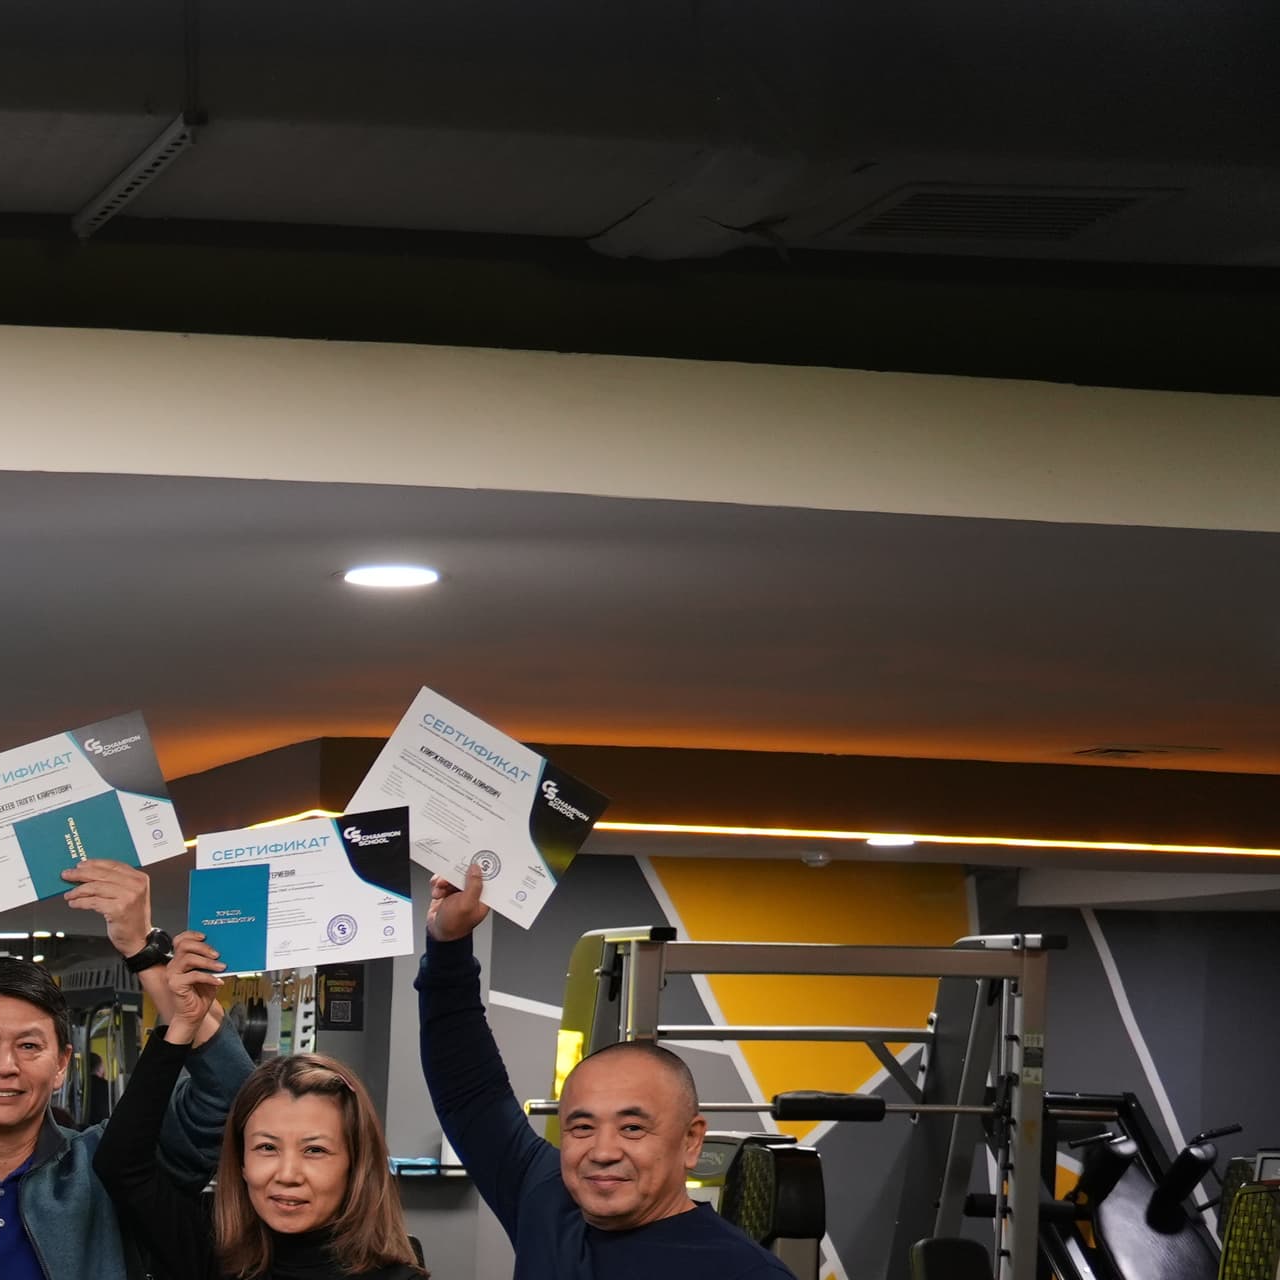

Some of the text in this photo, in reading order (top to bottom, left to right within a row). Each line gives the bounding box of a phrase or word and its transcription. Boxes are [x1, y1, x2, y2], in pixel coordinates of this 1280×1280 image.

[101, 733, 142, 751] CHAMPION
[101, 742, 132, 757] SCHOOL
[423, 713, 529, 780] СЕРТИФИКАТ
[547, 800, 574, 819] SCHOOL
[552, 797, 589, 821] CHAMPION
[357, 836, 389, 847] SCHOOL
[360, 829, 401, 841] CHAMPION
[212, 836, 328, 860] СЕРТИФИКАТ
